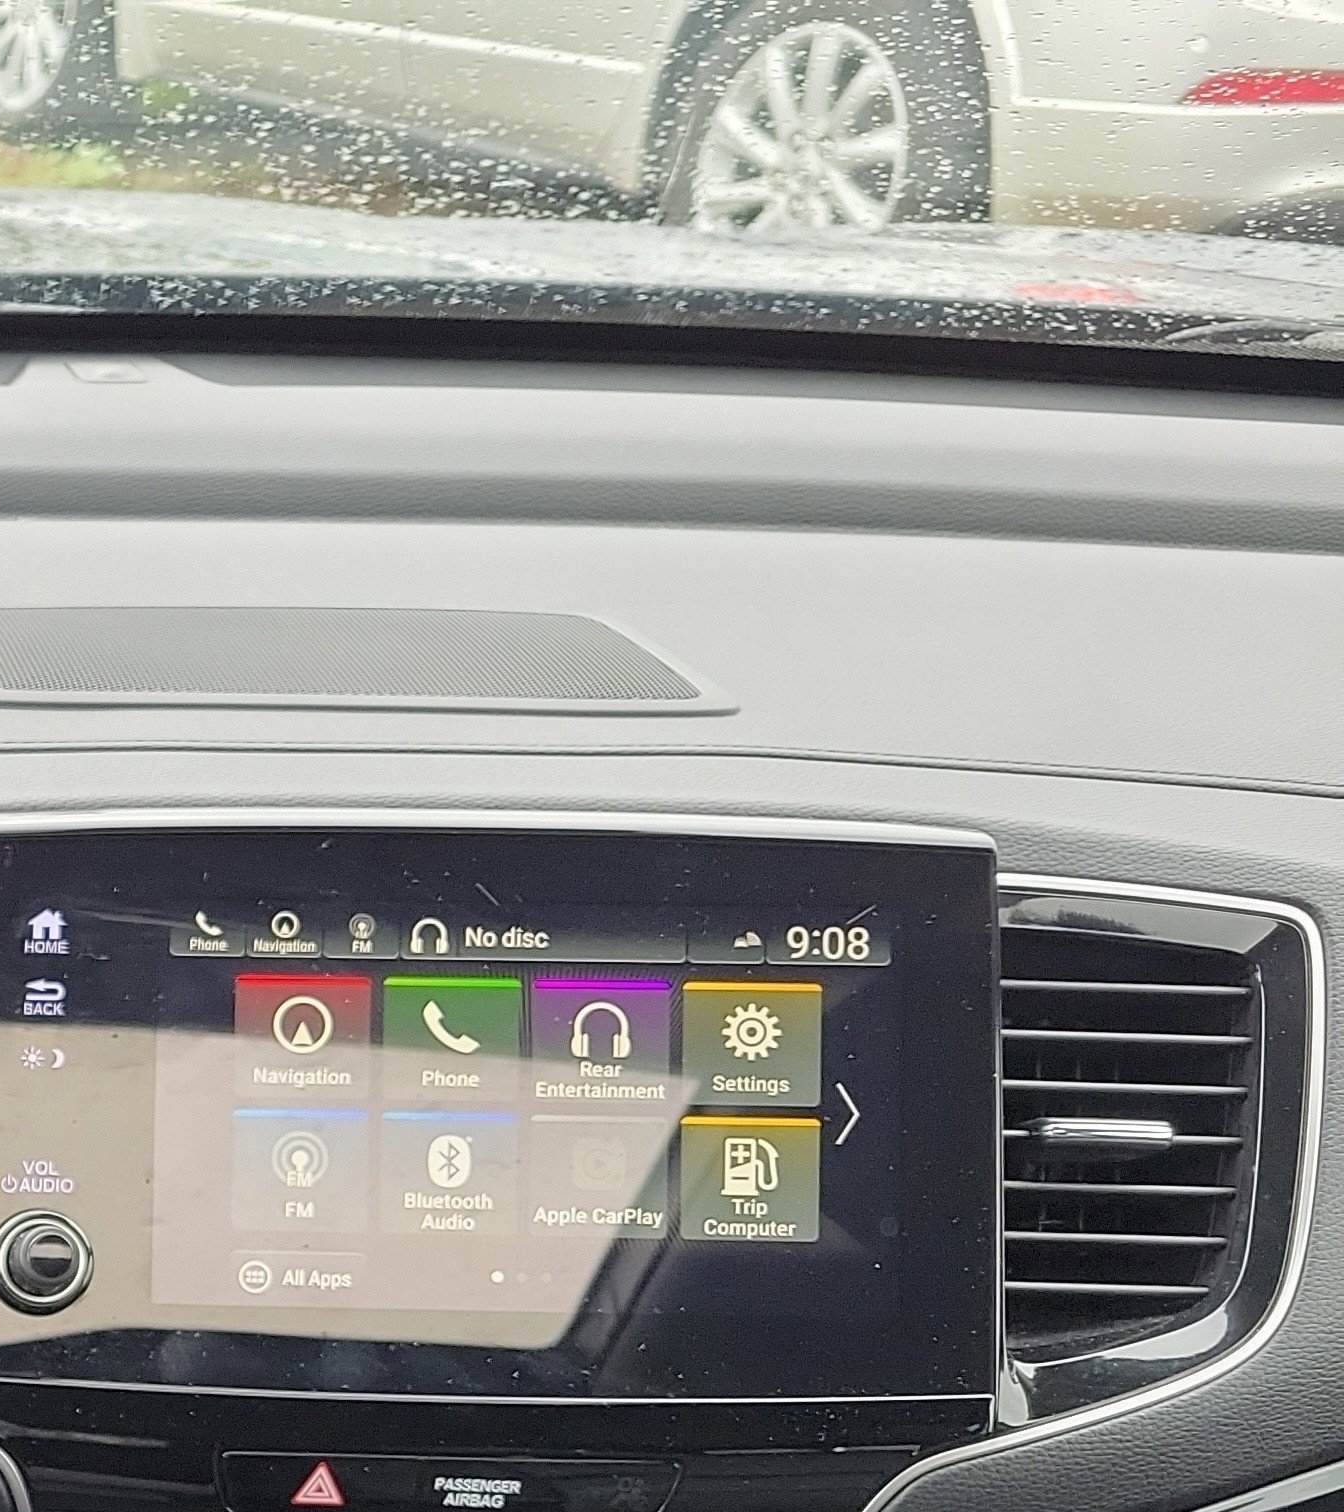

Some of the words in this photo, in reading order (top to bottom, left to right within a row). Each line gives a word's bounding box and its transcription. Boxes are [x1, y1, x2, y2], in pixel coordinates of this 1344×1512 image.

[23, 939, 70, 955] HOME
[189, 936, 229, 951] Phone
[253, 938, 317, 955] Navigation
[352, 941, 373, 954] FM
[464, 927, 499, 949] No
[501, 926, 551, 950] disc
[785, 925, 871, 960] 9:08
[23, 1001, 66, 1016] BACK
[253, 1068, 352, 1088] Navigation
[421, 1070, 481, 1089] Phone
[580, 1061, 622, 1080] Rear
[534, 1081, 666, 1101] Entertainment
[712, 1074, 791, 1096] Settings
[22, 1160, 59, 1176] VOL
[19, 1177, 74, 1194] AUDIO
[284, 1201, 314, 1219] FM
[403, 1193, 493, 1212] Bluetooth
[731, 1198, 768, 1219] Trip
[421, 1213, 475, 1231] Audio
[533, 1206, 588, 1228] Apple
[591, 1207, 664, 1229] CarPlay
[704, 1219, 797, 1241] Computer
[281, 1270, 307, 1287] All
[308, 1270, 353, 1290] Apps
[434, 1477, 521, 1494] PASSENGER
[444, 1493, 504, 1508] AIRBAG
